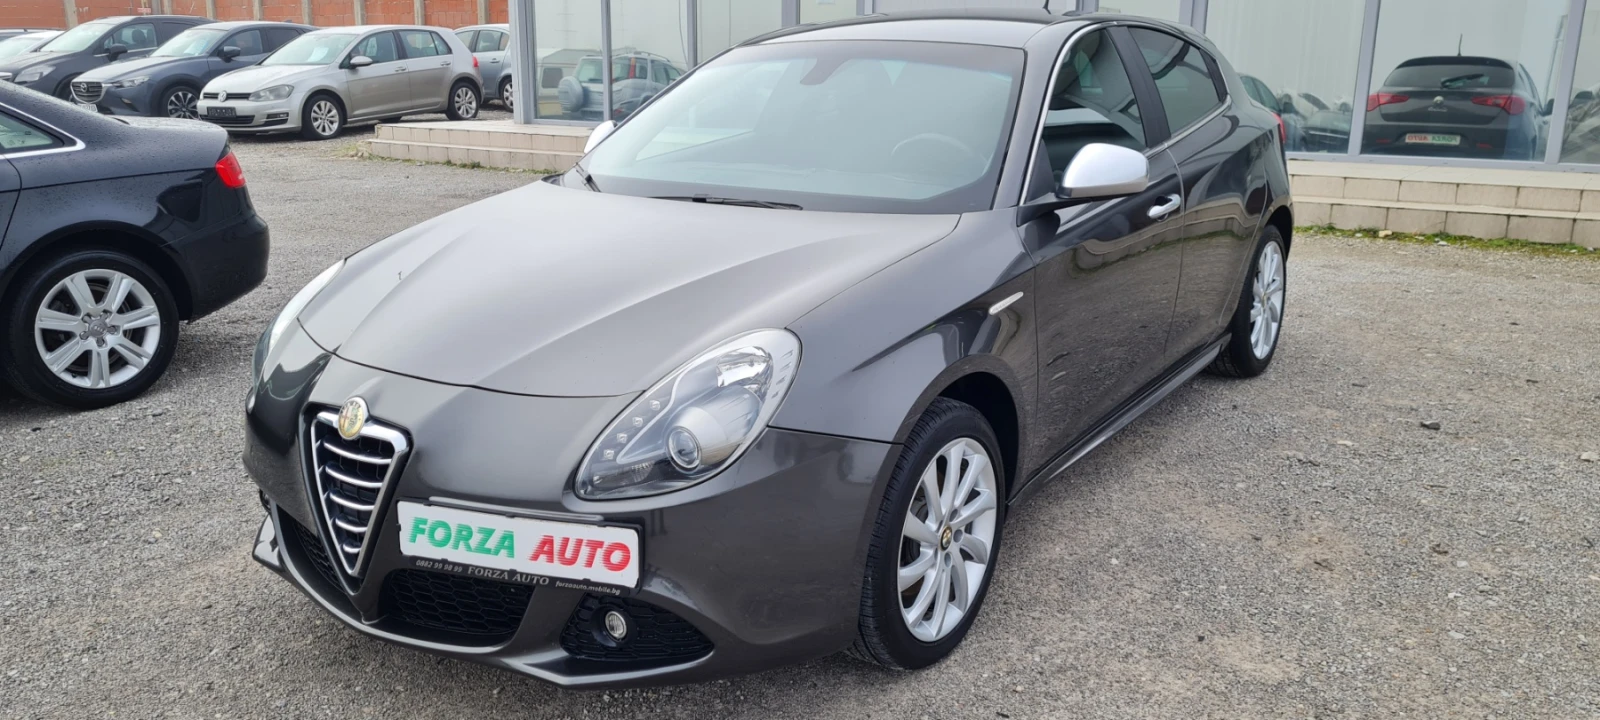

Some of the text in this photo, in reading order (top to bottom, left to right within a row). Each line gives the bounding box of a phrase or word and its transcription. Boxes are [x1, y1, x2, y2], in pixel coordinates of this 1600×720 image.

[409, 517, 631, 572] FORZA AUTO
[468, 566, 508, 580] FORZA
[512, 573, 549, 585] AUTO
[555, 580, 621, 595] forzaauto.mobile.bg
